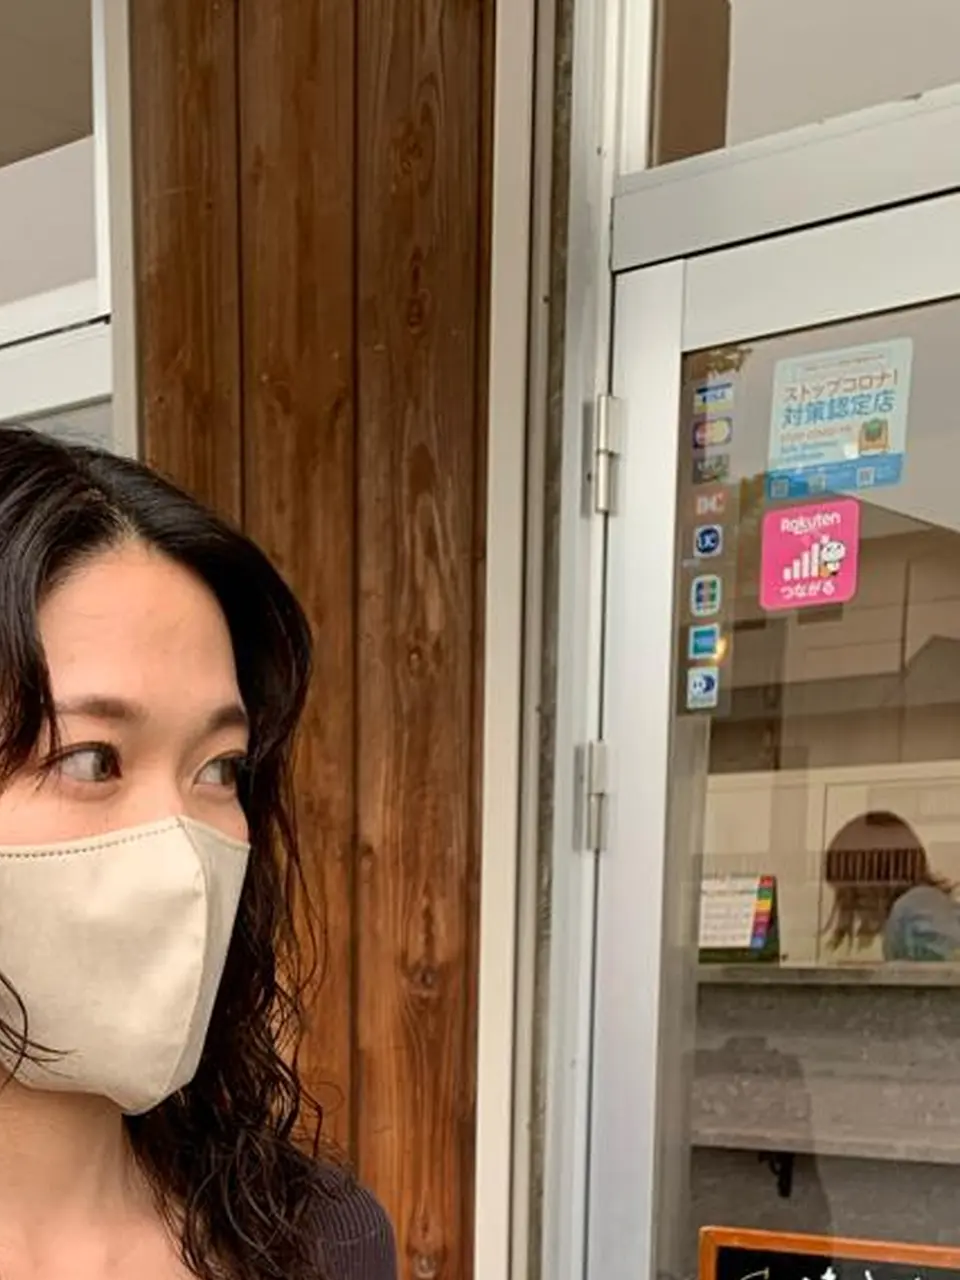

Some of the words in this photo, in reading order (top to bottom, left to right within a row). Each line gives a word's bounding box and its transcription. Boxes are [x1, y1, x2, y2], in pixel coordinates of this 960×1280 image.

[780, 511, 841, 535] Rakuten
[780, 581, 835, 600] つながる
